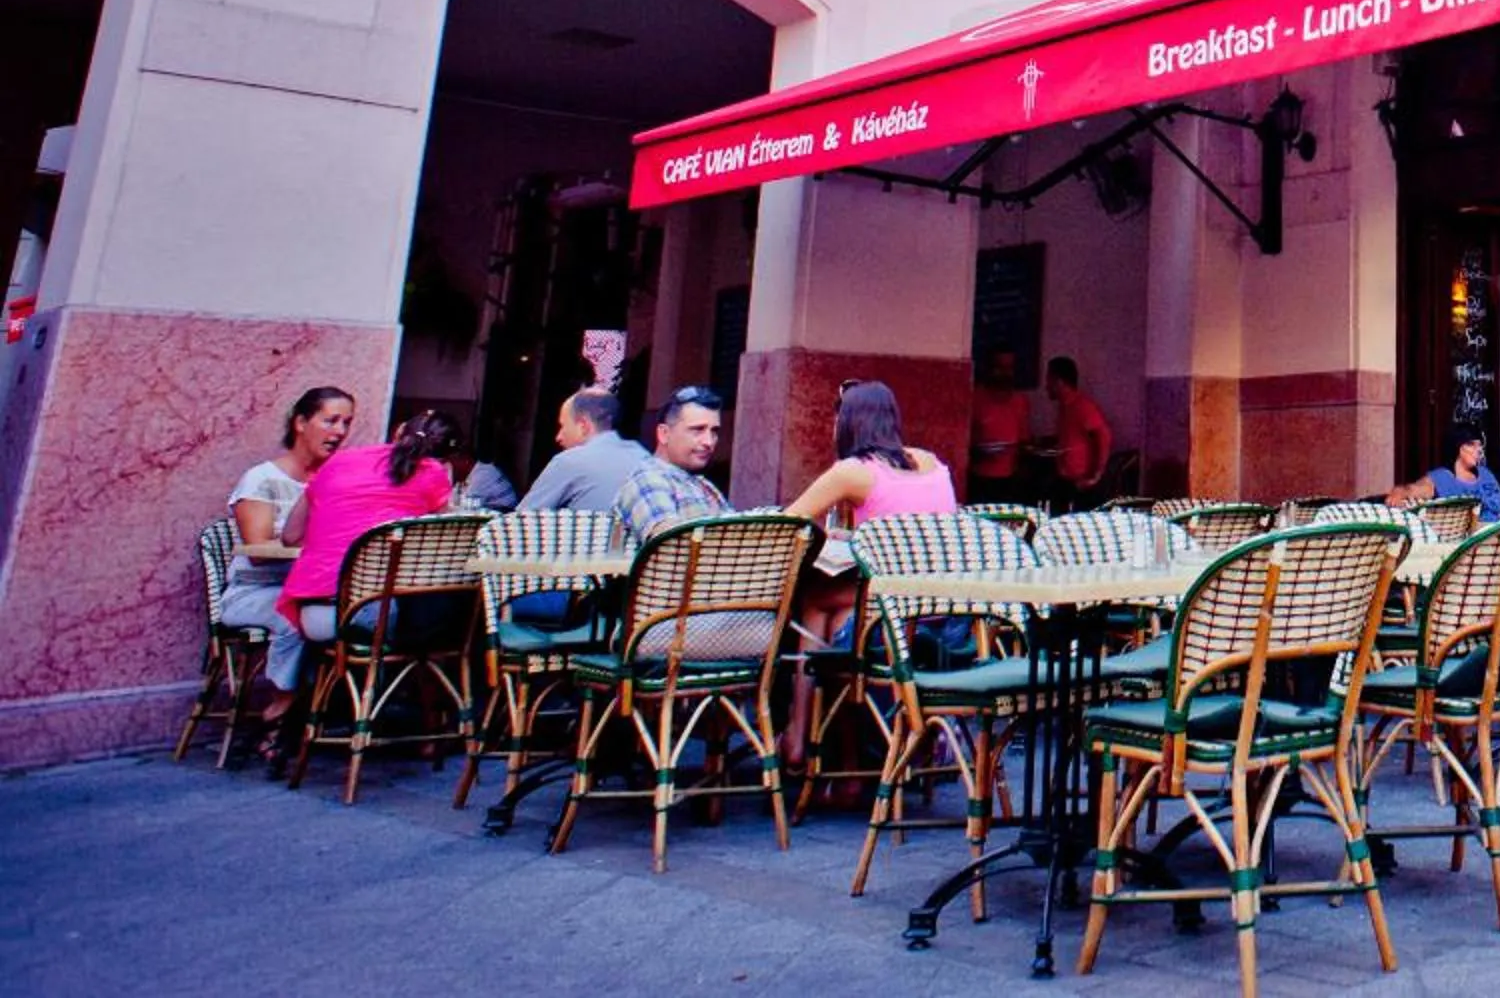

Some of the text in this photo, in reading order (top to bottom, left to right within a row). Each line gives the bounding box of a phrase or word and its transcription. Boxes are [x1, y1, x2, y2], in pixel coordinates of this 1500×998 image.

[1147, 17, 1277, 77] Breakfast
[663, 100, 930, 184] CAFÉ VIAN Étterem & Kávéház
